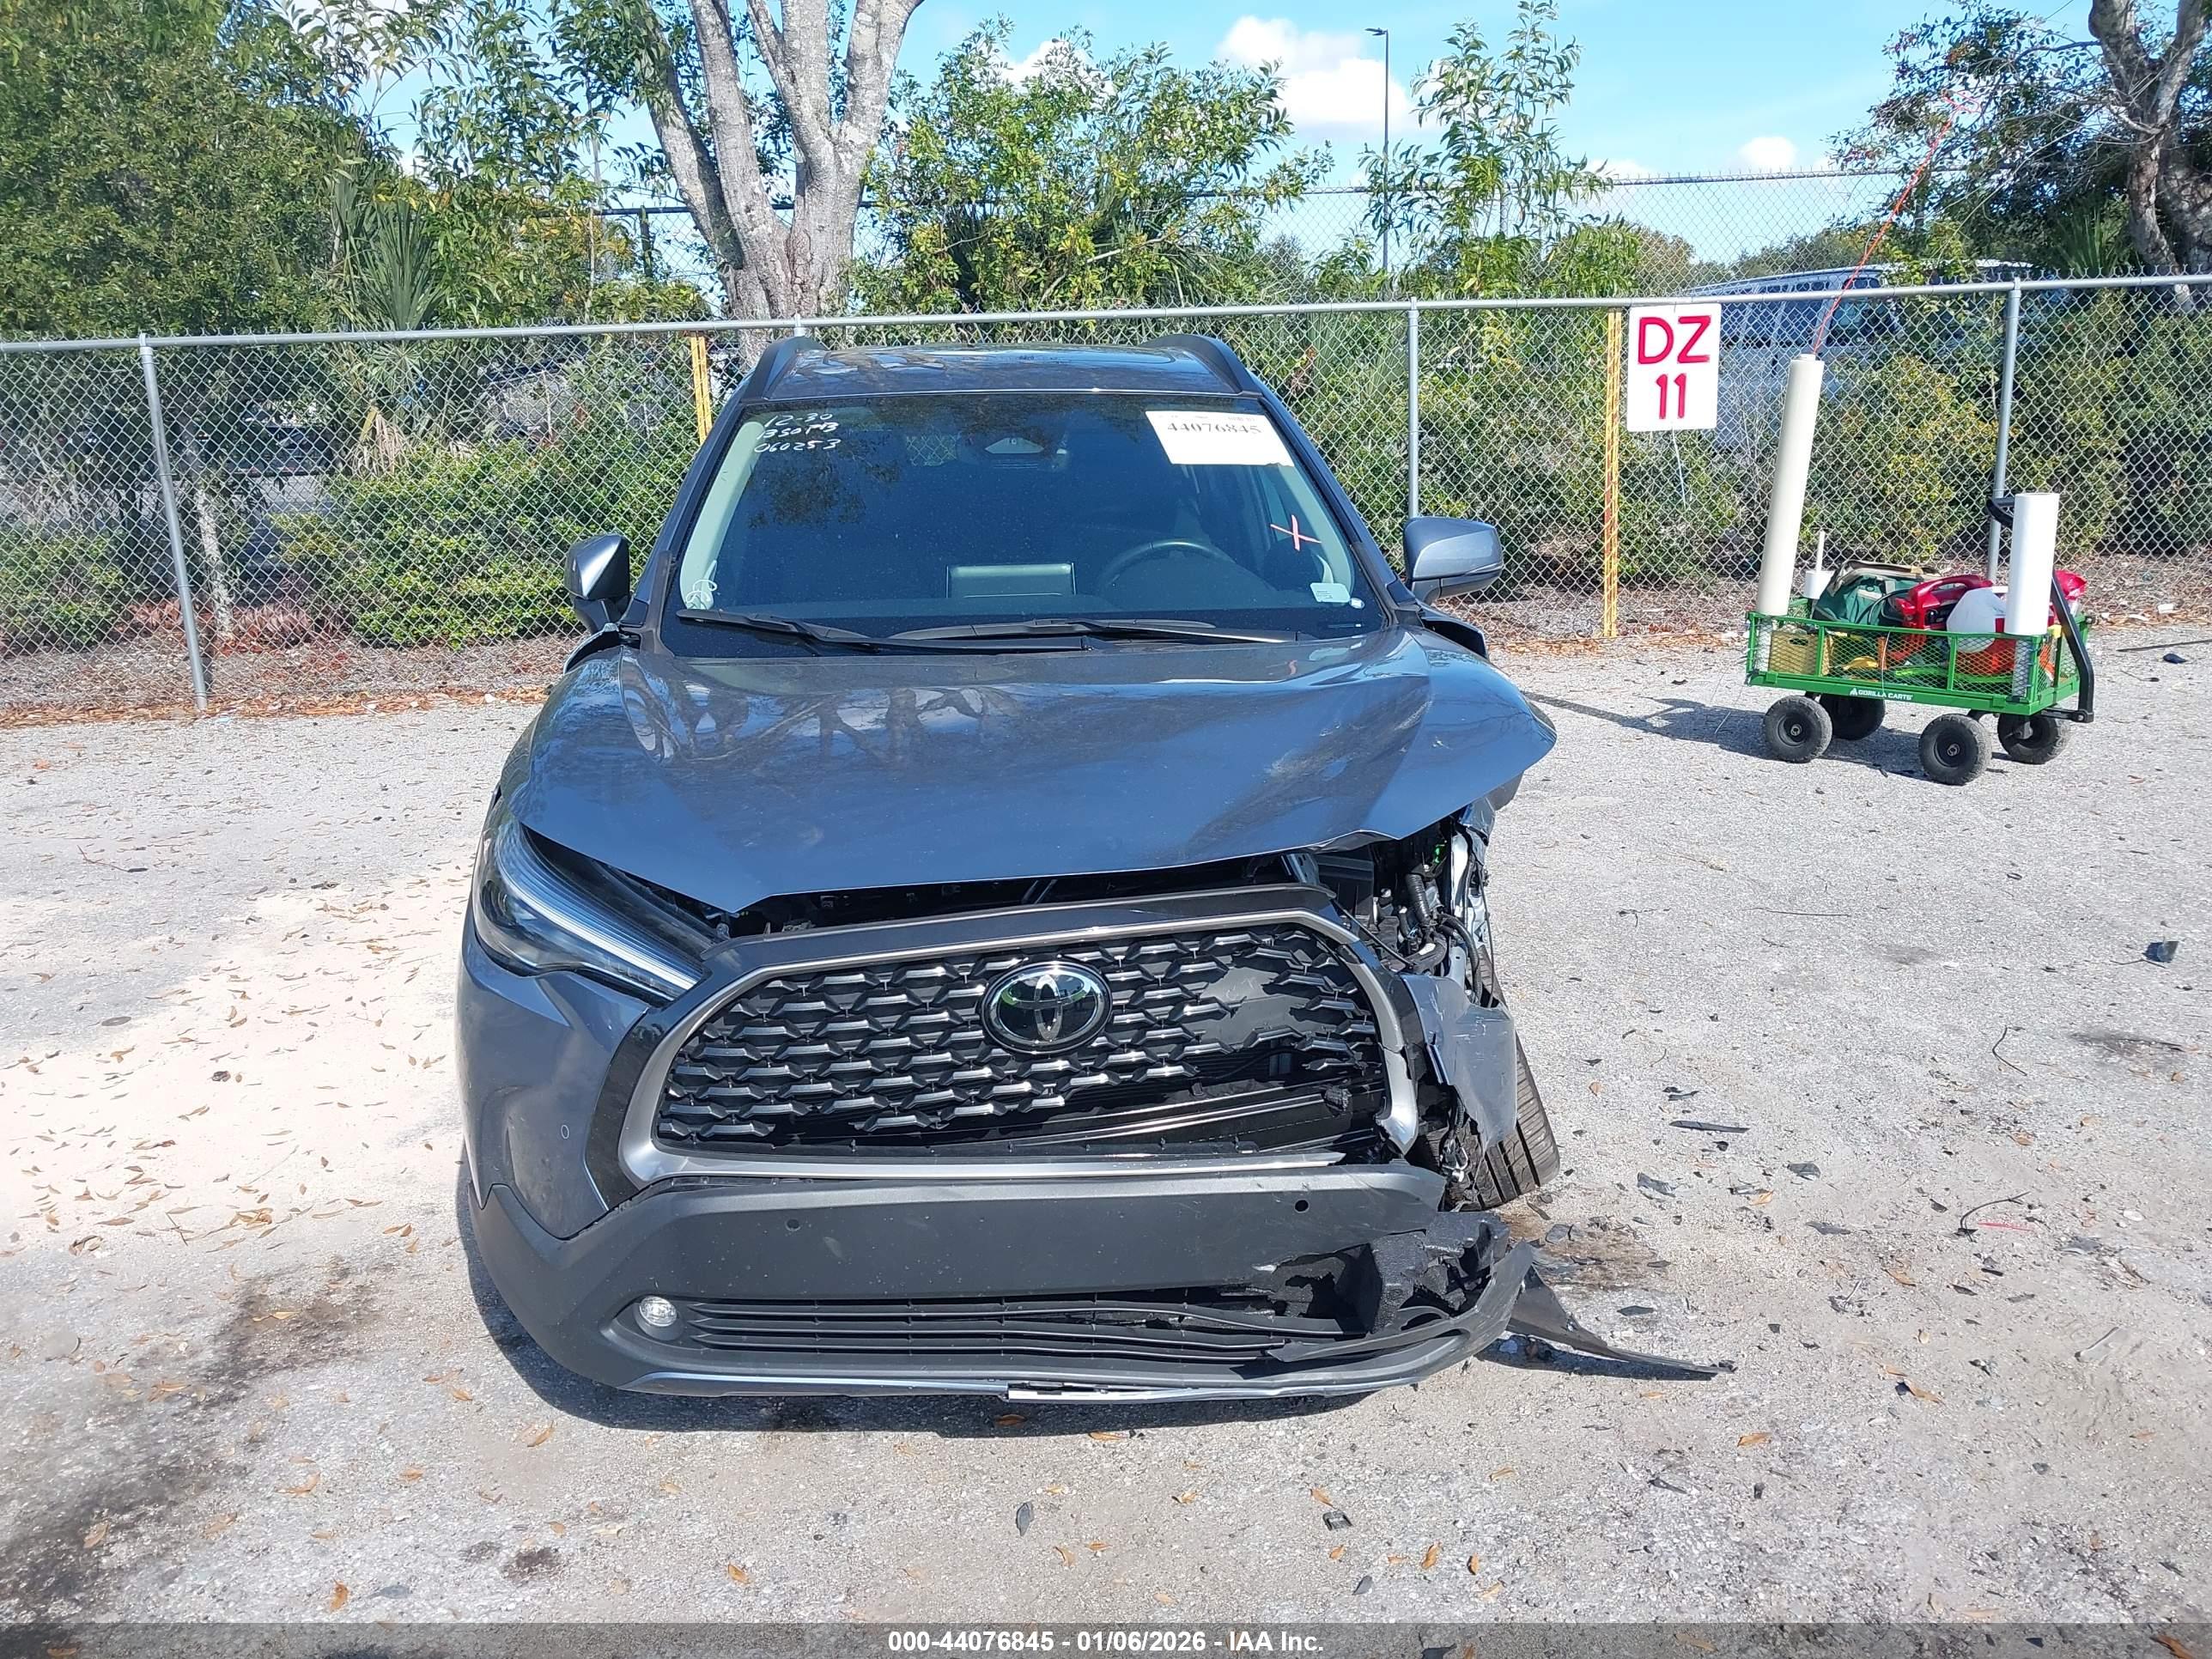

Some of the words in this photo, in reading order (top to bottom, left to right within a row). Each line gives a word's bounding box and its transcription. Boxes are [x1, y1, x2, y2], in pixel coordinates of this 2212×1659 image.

[1638, 315, 1711, 365] DZ
[1656, 373, 1686, 419] 11
[764, 412, 833, 428] 12-30
[1168, 422, 1263, 434] 44076845
[754, 438, 842, 453] 060253
[1887, 692, 1912, 701] CARTS
